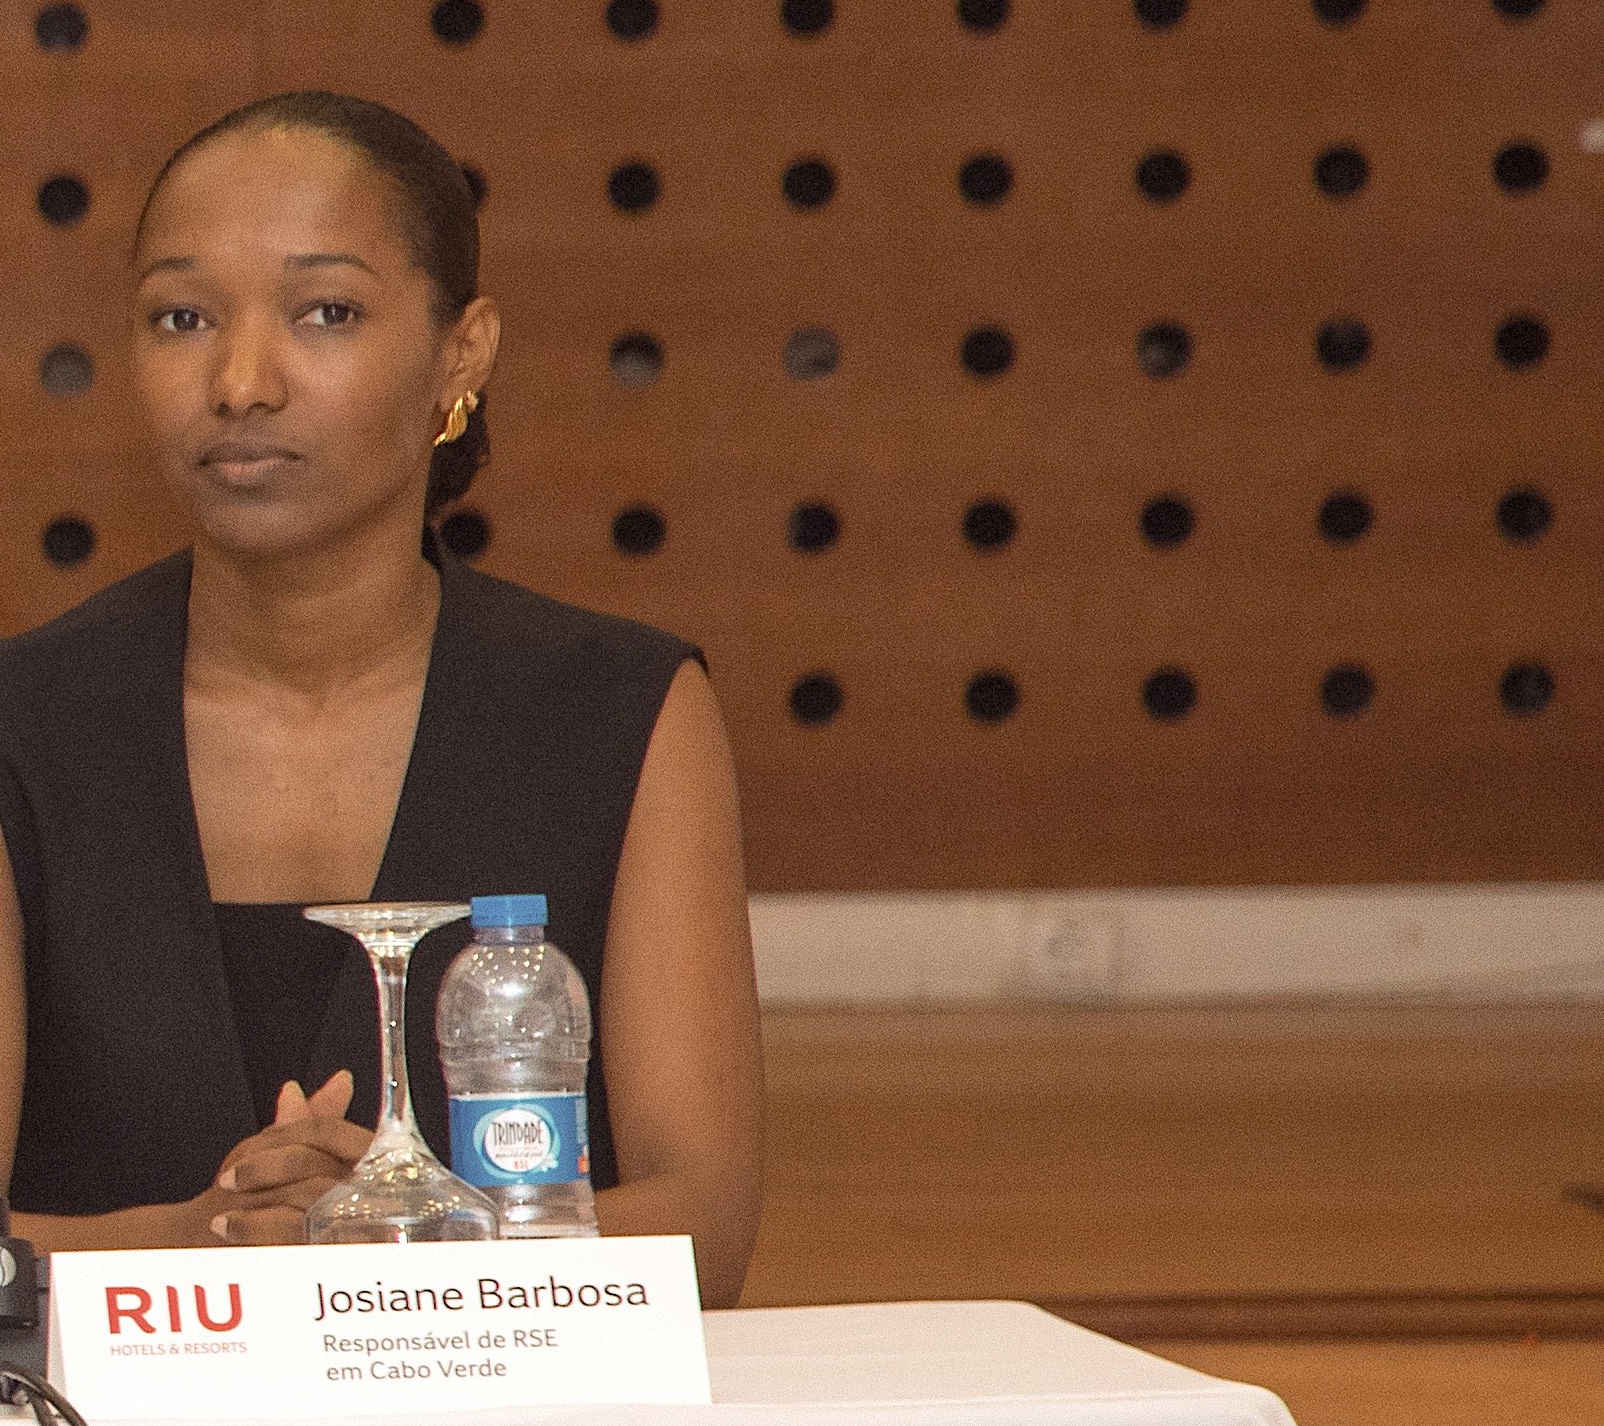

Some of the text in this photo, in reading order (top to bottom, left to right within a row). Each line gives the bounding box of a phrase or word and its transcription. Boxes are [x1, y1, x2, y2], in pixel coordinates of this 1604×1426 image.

[493, 1119, 542, 1146] TRINDADE
[103, 1282, 244, 1336] RIU
[313, 1274, 651, 1322] Josiane Barbosa
[111, 1341, 248, 1356] HOTELS & RESORTS
[322, 1328, 559, 1357] Responsável de RSE
[326, 1358, 507, 1382] em Cabo Verde
